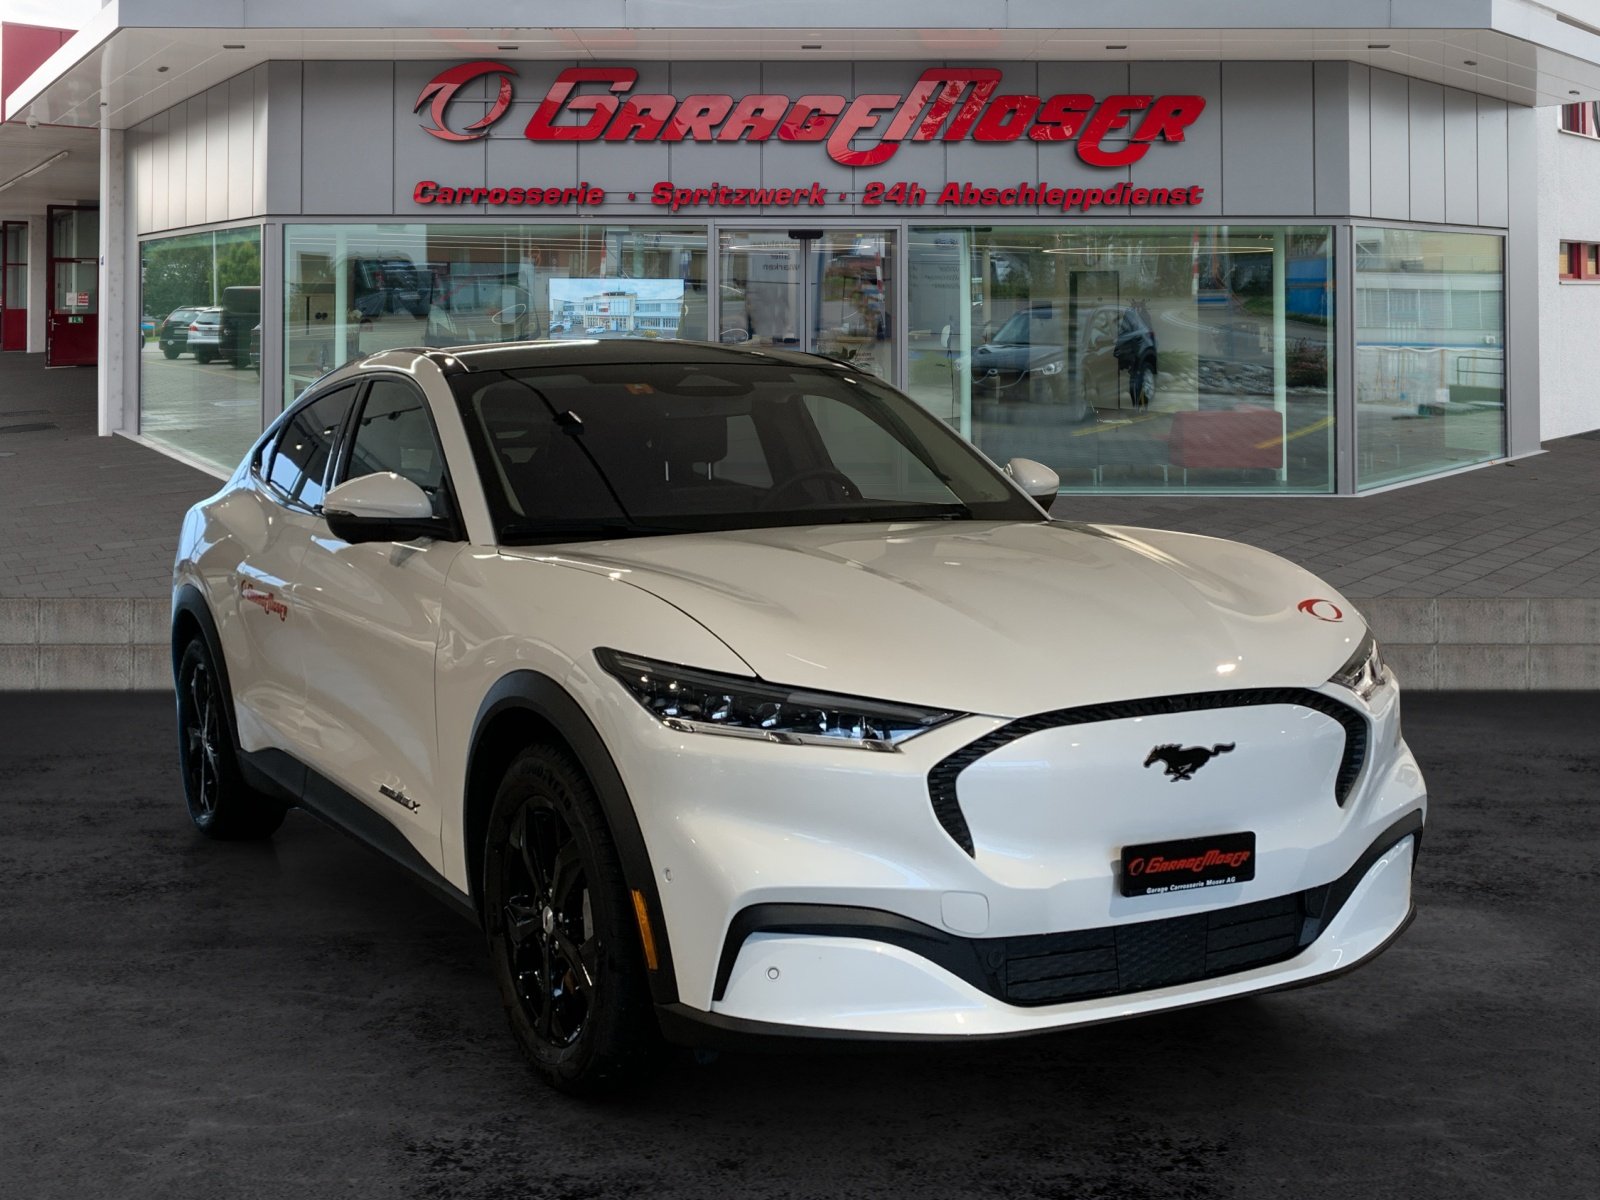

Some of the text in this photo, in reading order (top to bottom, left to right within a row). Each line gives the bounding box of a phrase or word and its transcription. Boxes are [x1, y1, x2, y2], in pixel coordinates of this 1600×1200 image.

[413, 180, 1204, 211] Carrosserie Spritzwerk 24h Abschleppdienst
[1146, 886, 1168, 894] Garage
[1170, 881, 1204, 890] Carrosserie
[1206, 878, 1225, 886] Moser
